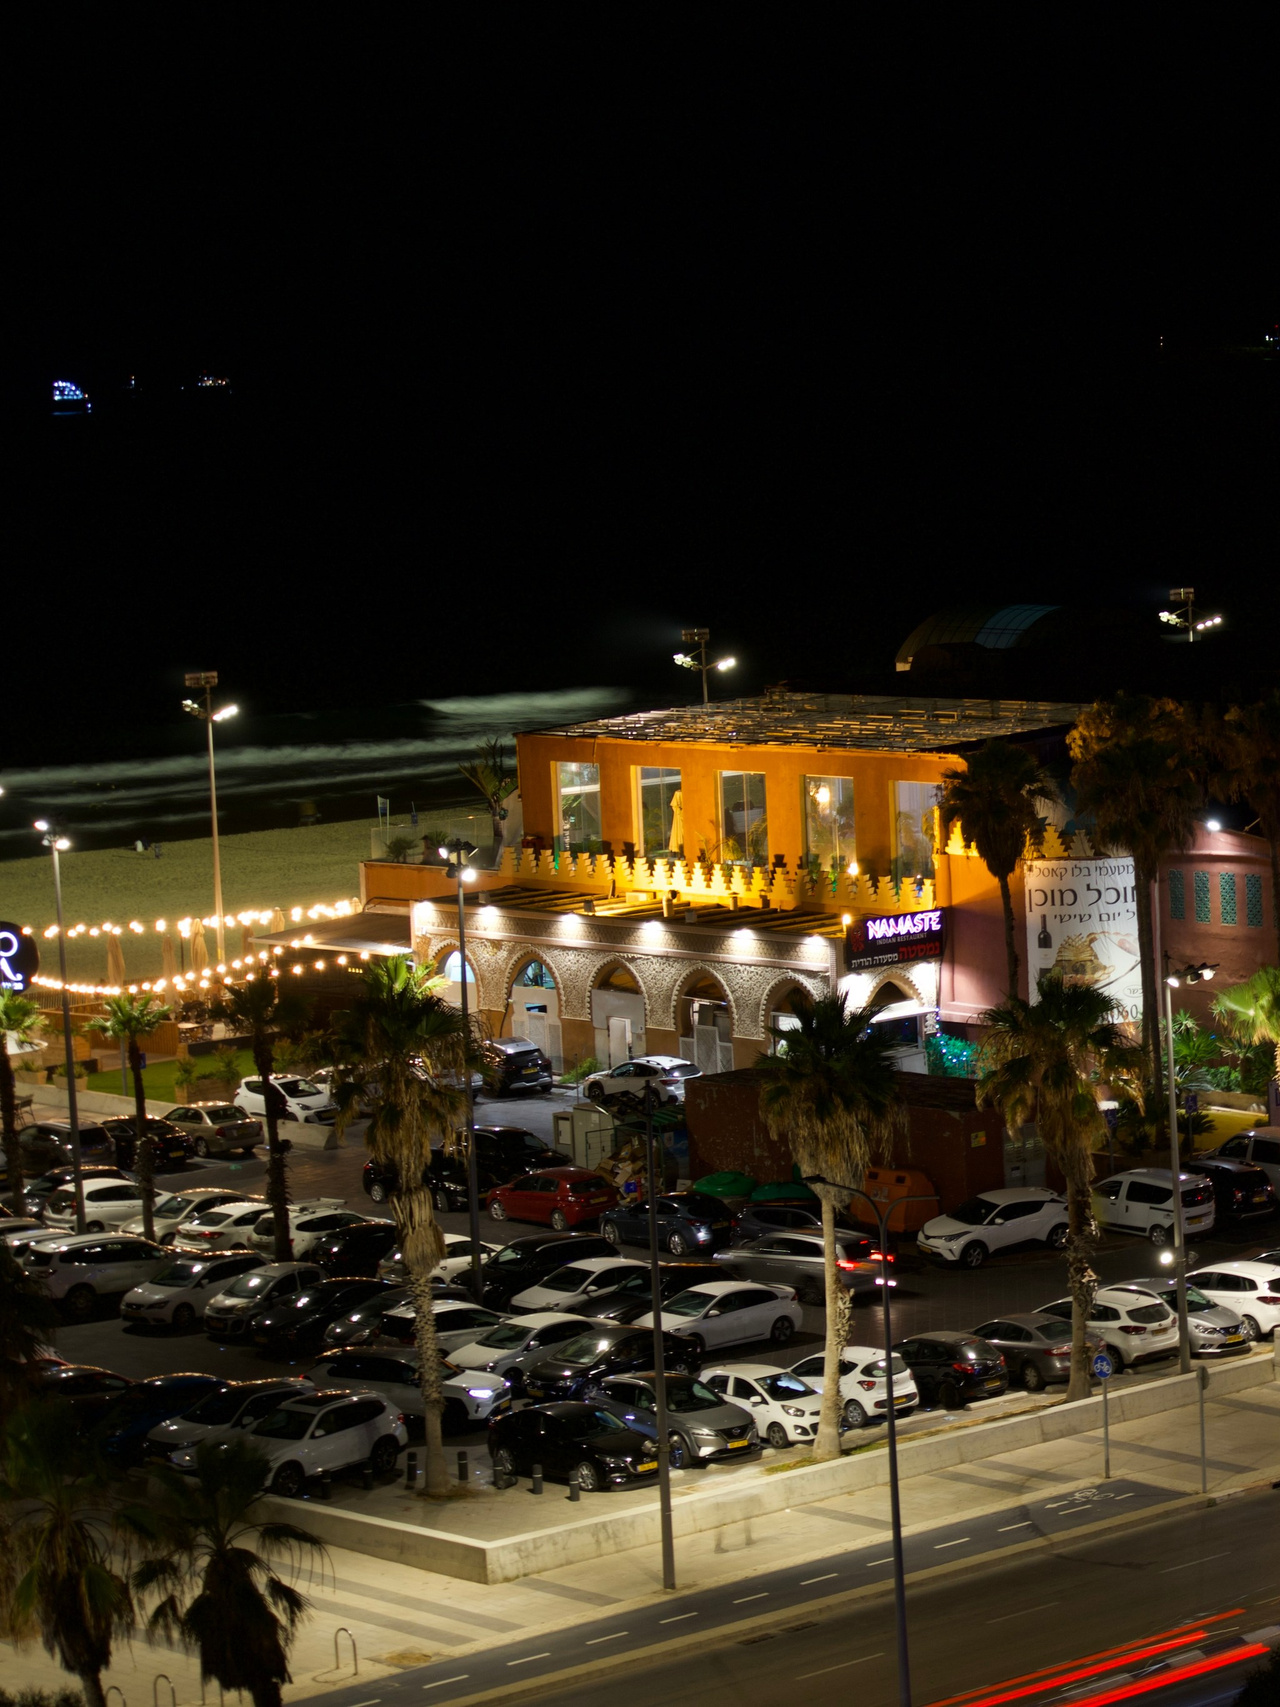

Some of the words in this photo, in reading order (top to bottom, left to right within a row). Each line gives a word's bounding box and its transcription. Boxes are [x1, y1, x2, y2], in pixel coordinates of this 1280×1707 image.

[1071, 864, 1091, 877] בלו
[1028, 887, 1078, 913] מוכן
[1054, 913, 1092, 924] שישי
[1099, 911, 1121, 922] יום
[867, 910, 942, 940] NAMASTE
[876, 935, 897, 946] INDIAN
[898, 941, 941, 961] נמסטה
[873, 953, 899, 965] מסעדה
